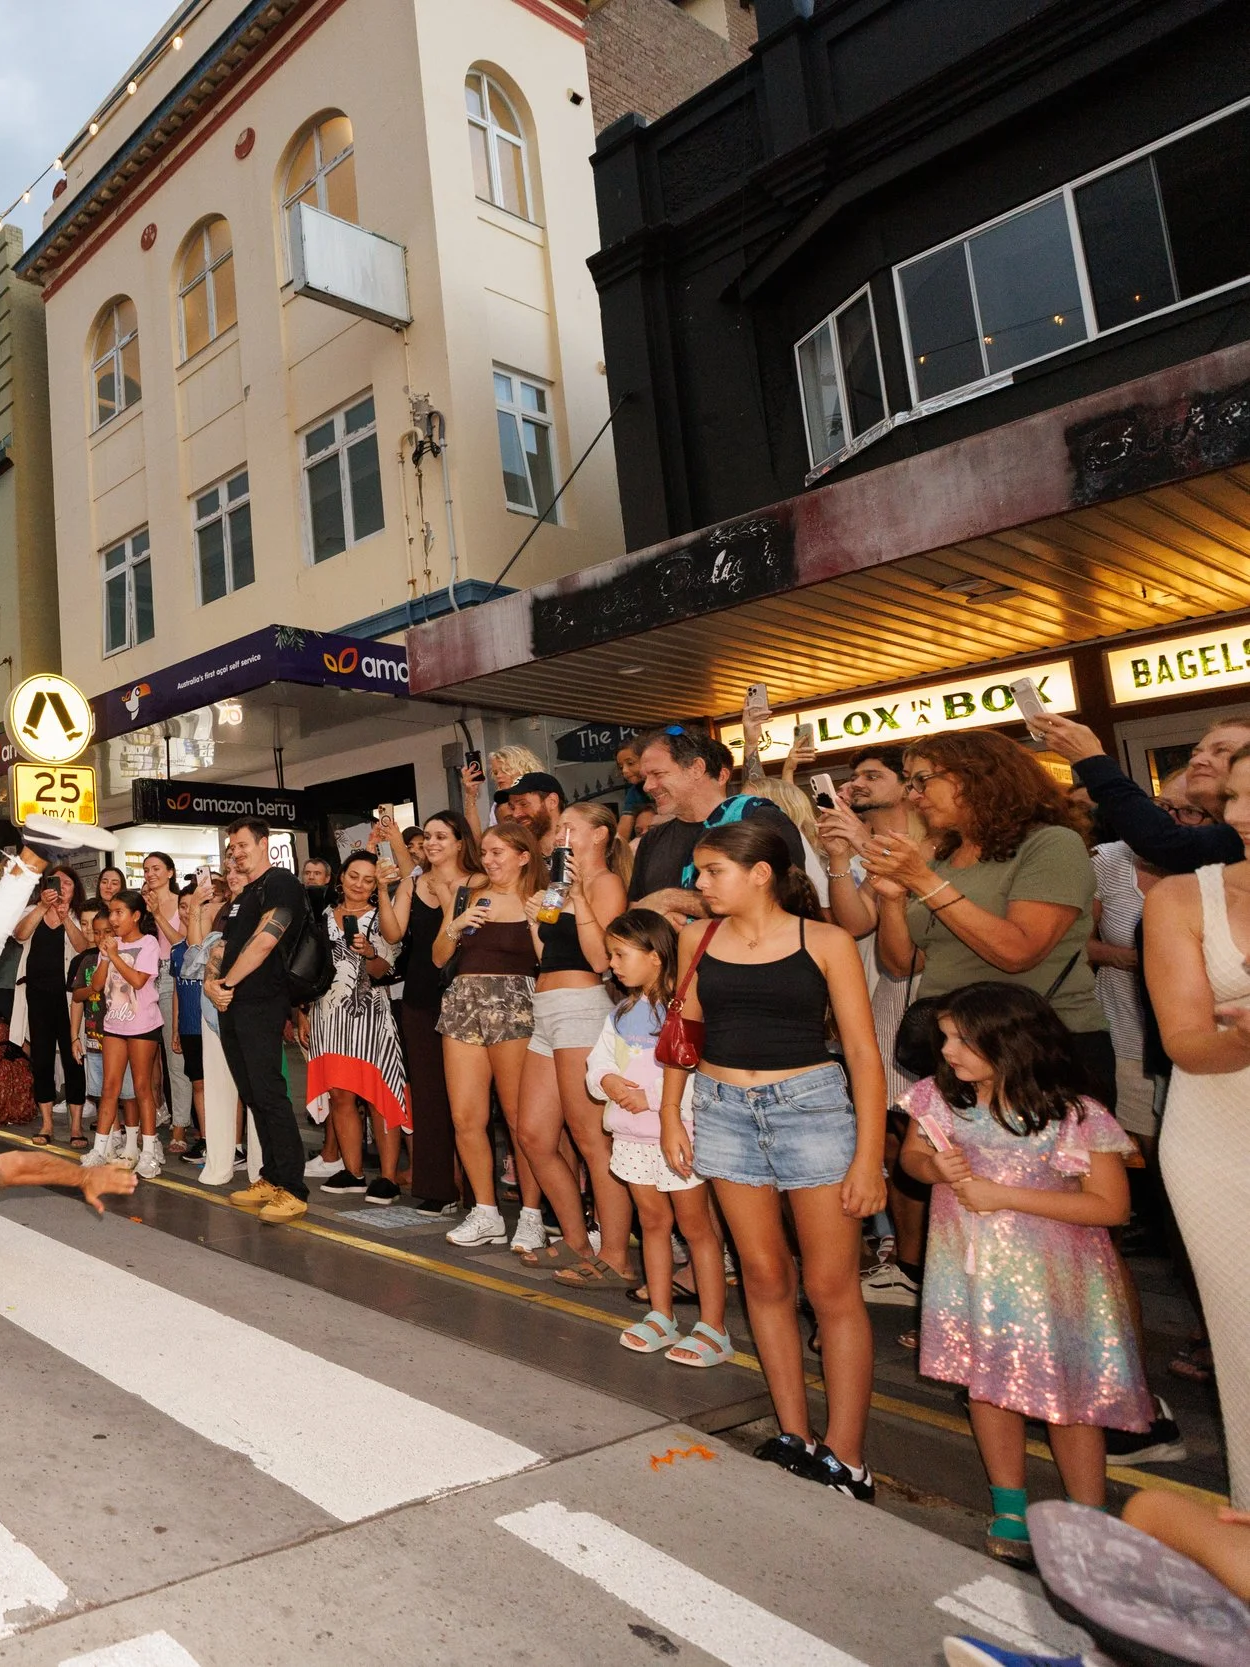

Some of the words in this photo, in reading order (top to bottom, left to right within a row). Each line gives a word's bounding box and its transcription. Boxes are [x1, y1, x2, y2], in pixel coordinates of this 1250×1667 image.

[177, 674, 204, 690] Australia's
[204, 669, 216, 680] first
[229, 660, 240, 671] self
[241, 653, 262, 667] service
[911, 698, 932, 713] IN
[817, 704, 901, 742] LOX
[916, 713, 931, 727] A
[577, 729, 612, 749] The
[34, 772, 81, 804] 25
[42, 807, 75, 818] km/h
[192, 798, 254, 814] amazon
[256, 798, 296, 821] berry
